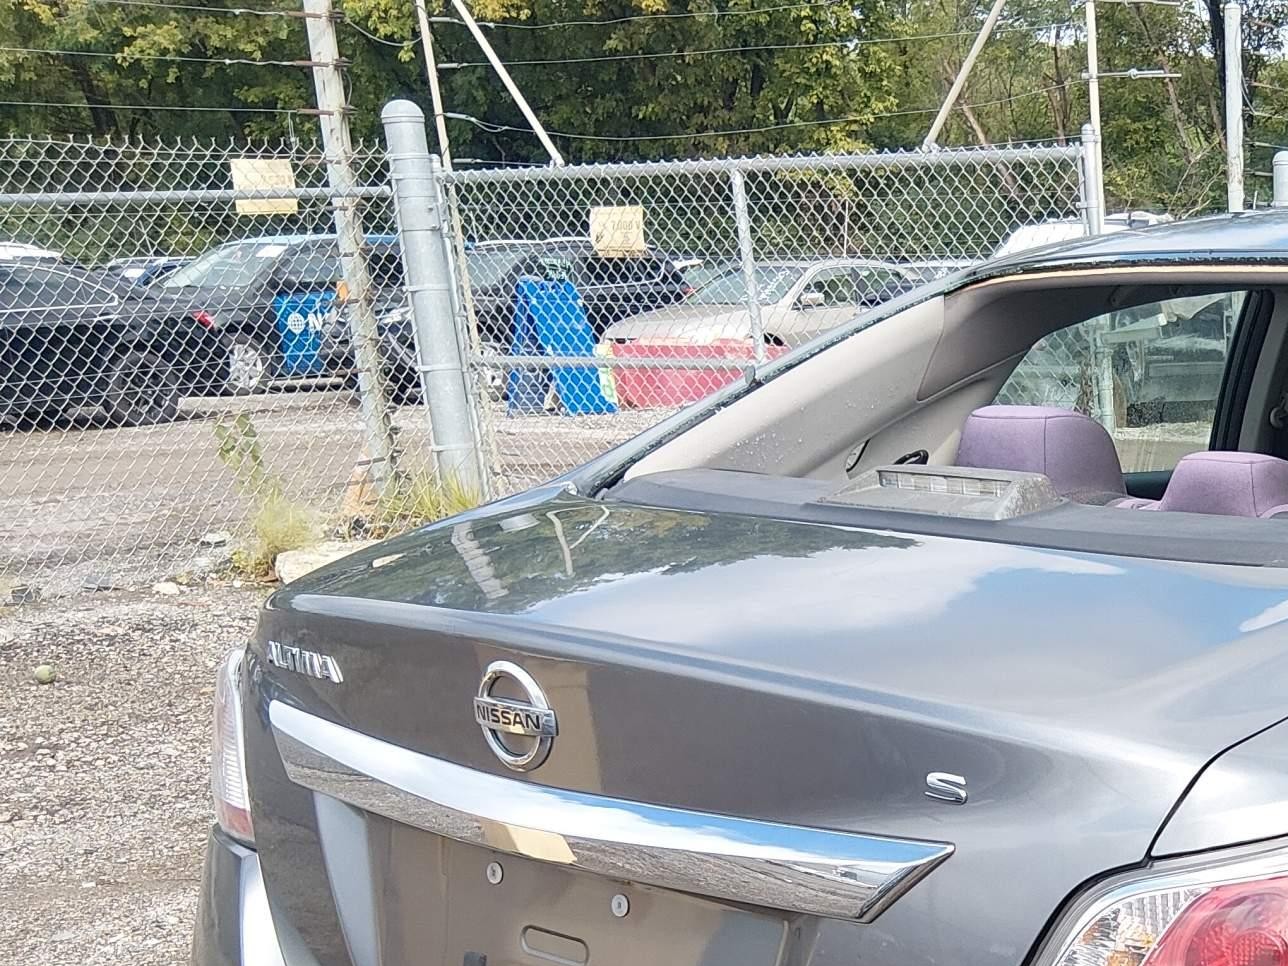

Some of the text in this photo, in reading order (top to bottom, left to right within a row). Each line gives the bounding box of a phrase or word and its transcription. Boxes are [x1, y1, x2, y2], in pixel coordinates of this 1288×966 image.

[267, 640, 344, 684] ALTIMA
[476, 704, 541, 731] NISSAN
[925, 771, 967, 805] S
